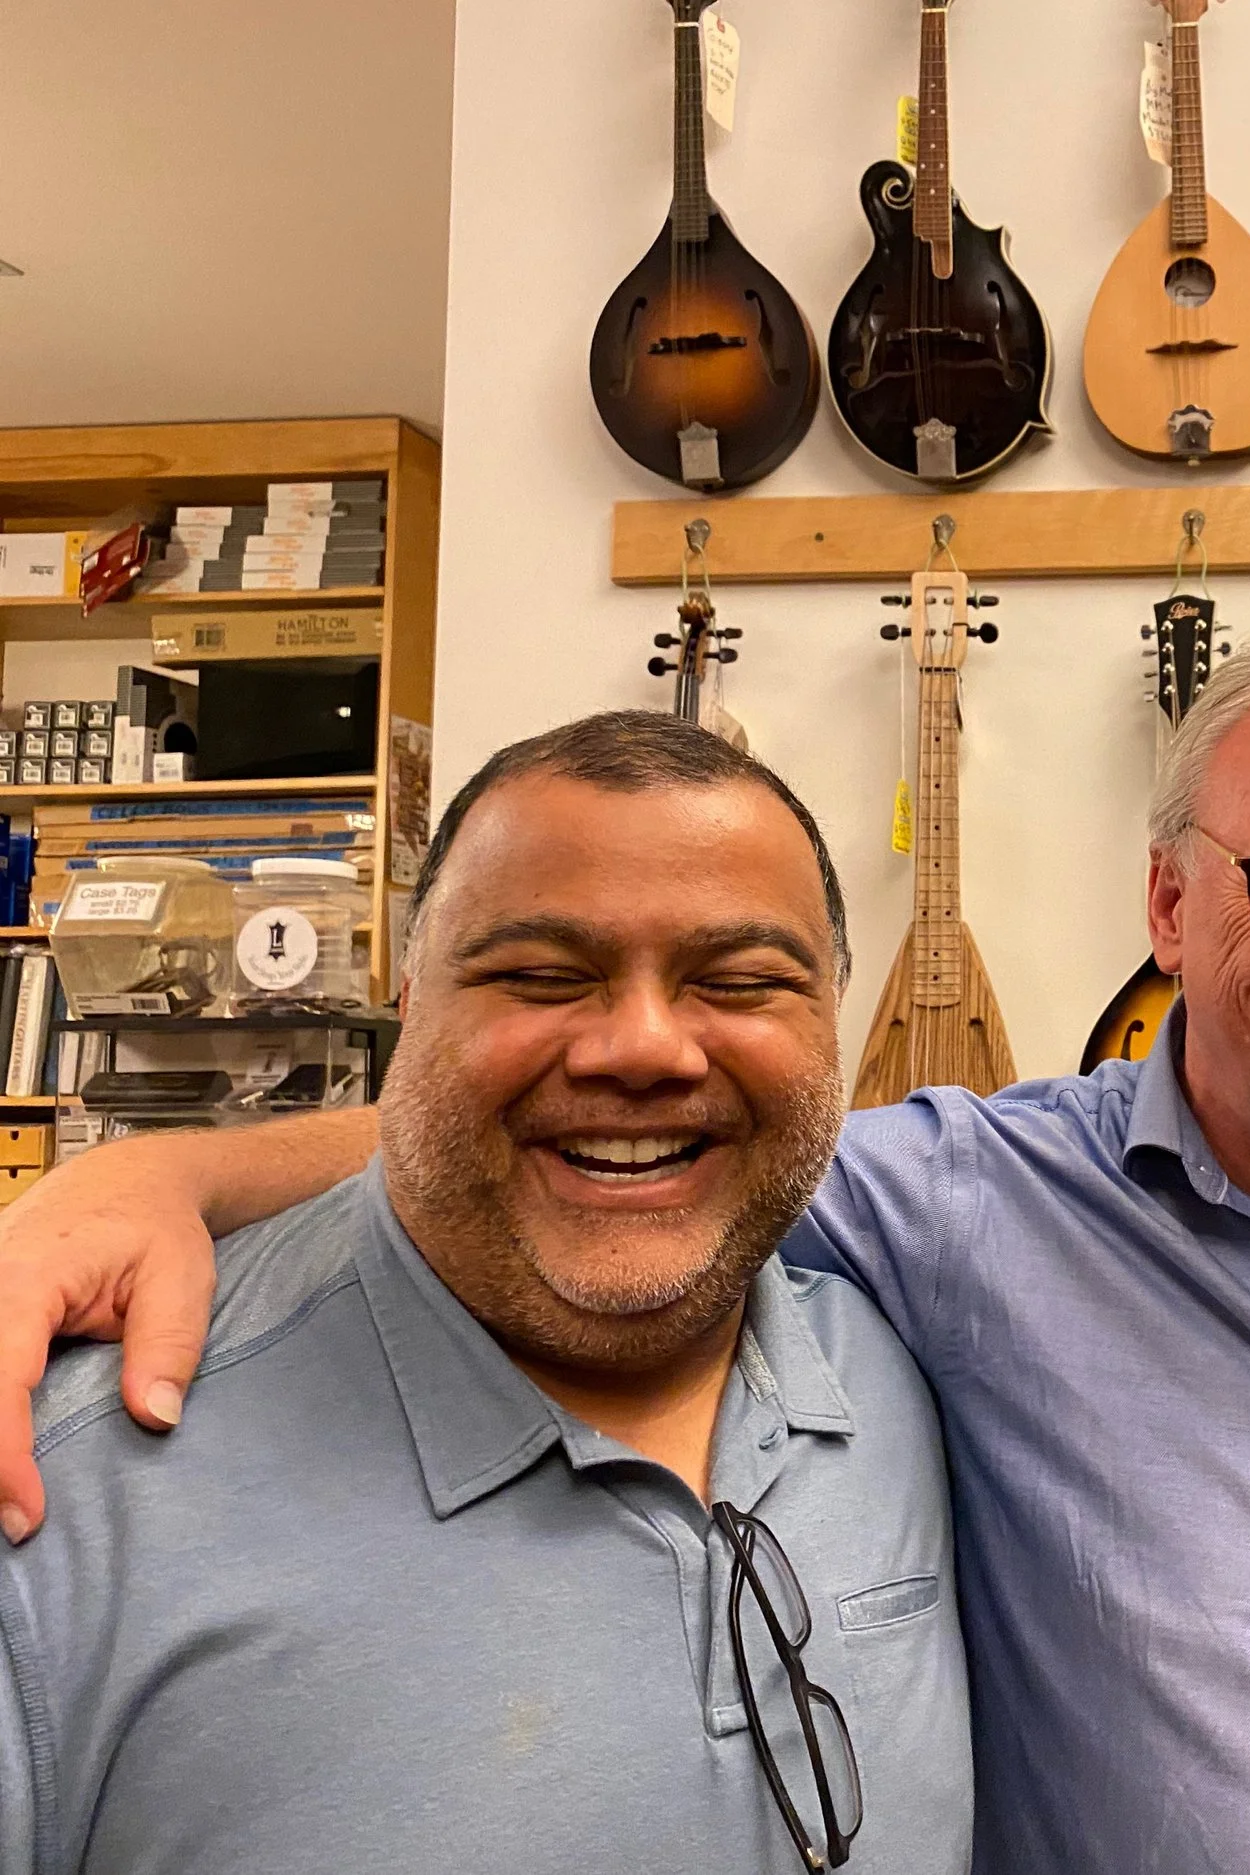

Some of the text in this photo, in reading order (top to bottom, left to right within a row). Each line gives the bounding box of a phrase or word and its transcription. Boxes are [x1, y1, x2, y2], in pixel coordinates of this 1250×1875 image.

[277, 615, 349, 631] HAMILTON
[80, 886, 156, 900] Case Tags
[273, 929, 282, 947] L
